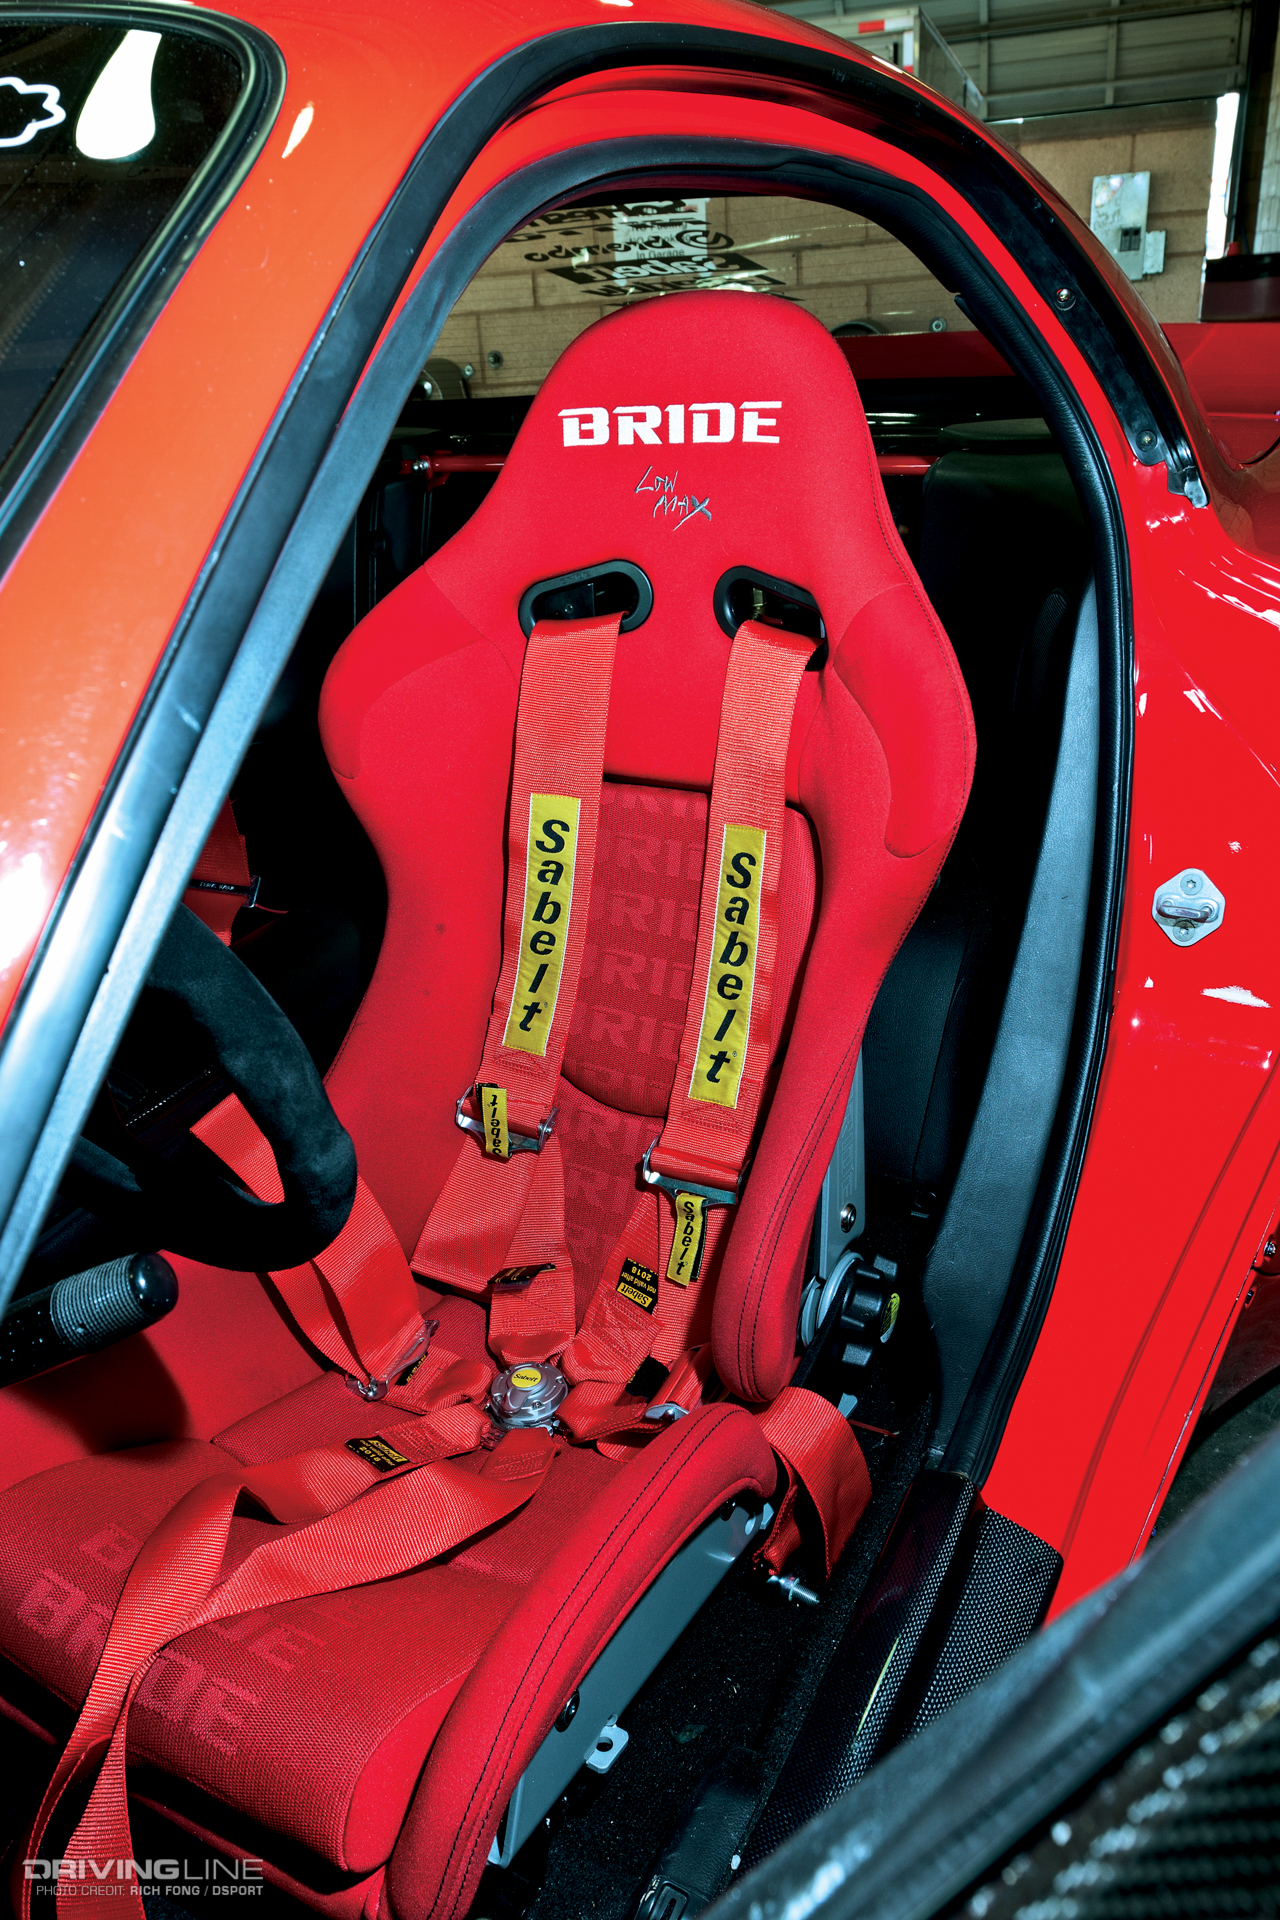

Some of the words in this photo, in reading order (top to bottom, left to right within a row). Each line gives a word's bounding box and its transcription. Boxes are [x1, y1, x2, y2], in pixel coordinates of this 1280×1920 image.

[557, 401, 783, 447] BRIDE
[521, 819, 570, 1032] Sabelt
[706, 851, 756, 1083] Sabelt
[676, 1201, 695, 1276] Sabelt
[620, 1284, 650, 1306] Sabelt
[631, 1266, 653, 1282] 2018
[513, 1373, 539, 1382] Sabelt
